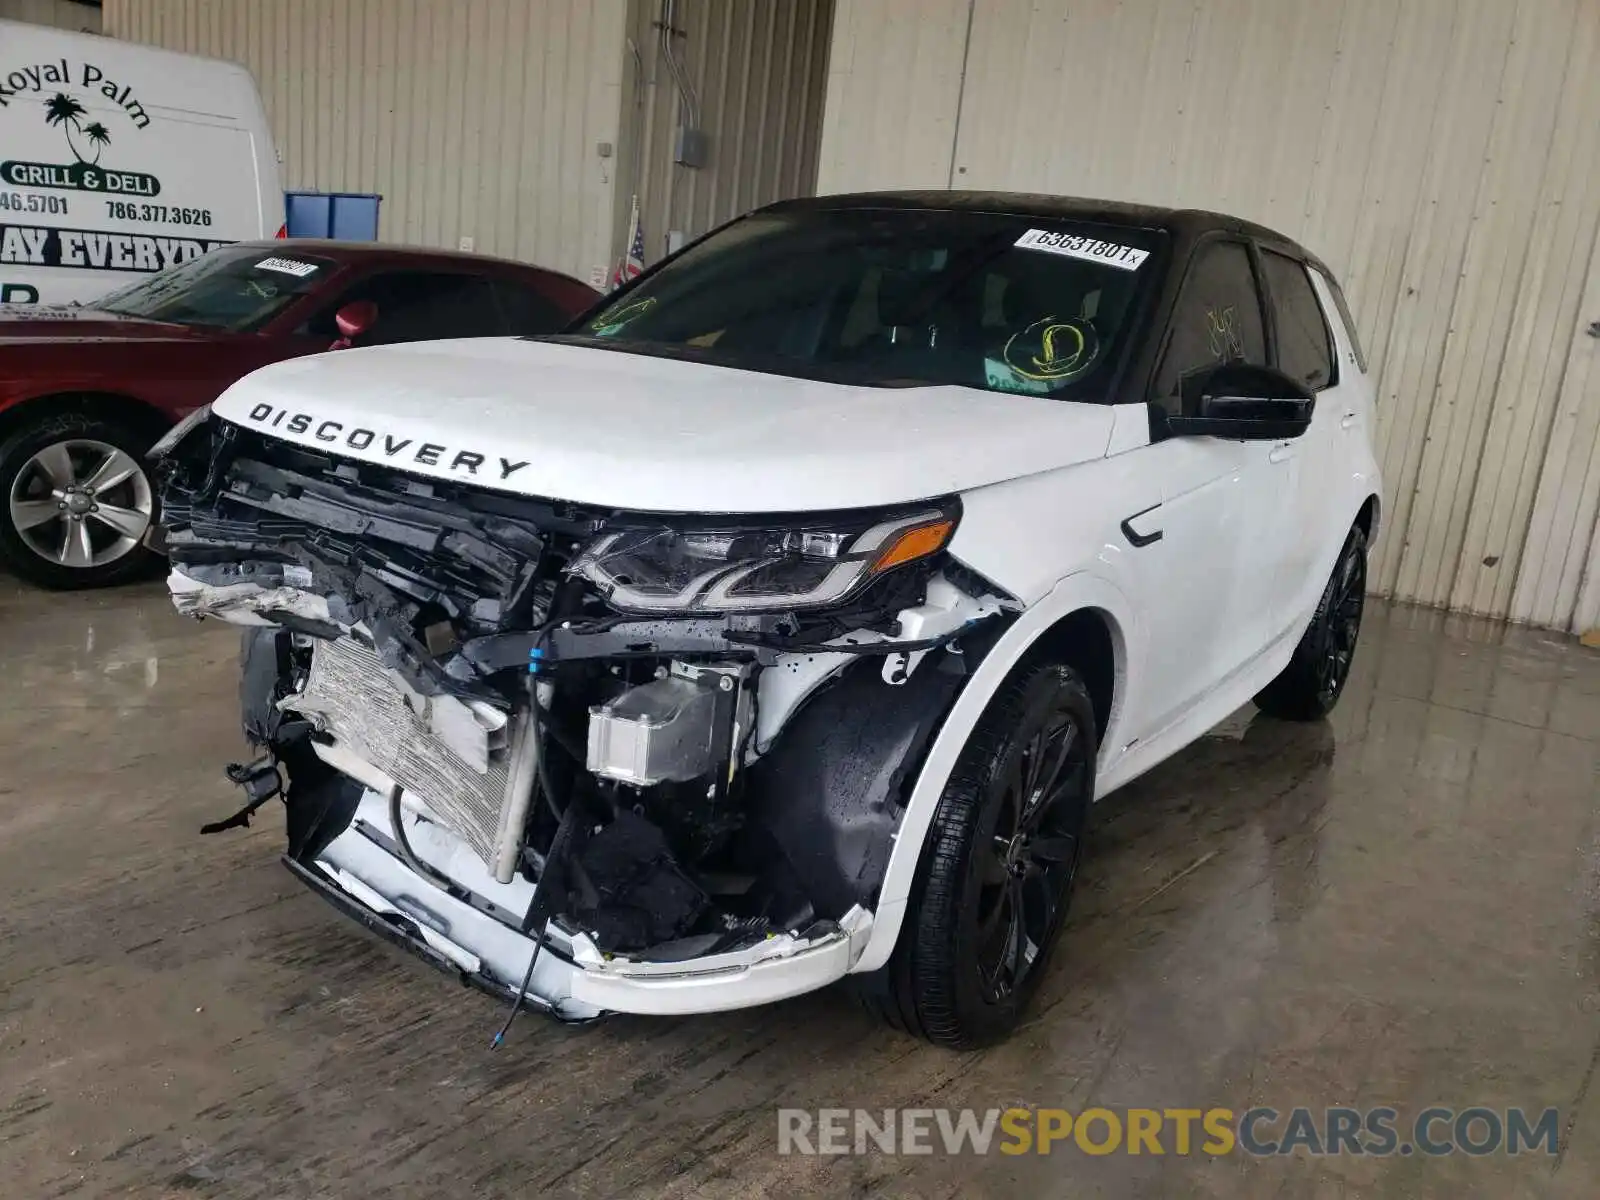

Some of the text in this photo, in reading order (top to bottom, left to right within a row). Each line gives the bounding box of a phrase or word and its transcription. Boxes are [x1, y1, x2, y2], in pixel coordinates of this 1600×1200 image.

[81, 63, 151, 130] Palm
[11, 165, 153, 194] GRILL & DELI
[106, 201, 212, 226] 786.377.3626
[57, 230, 233, 271] EVERYD
[249, 403, 531, 480] DISCOVERY
